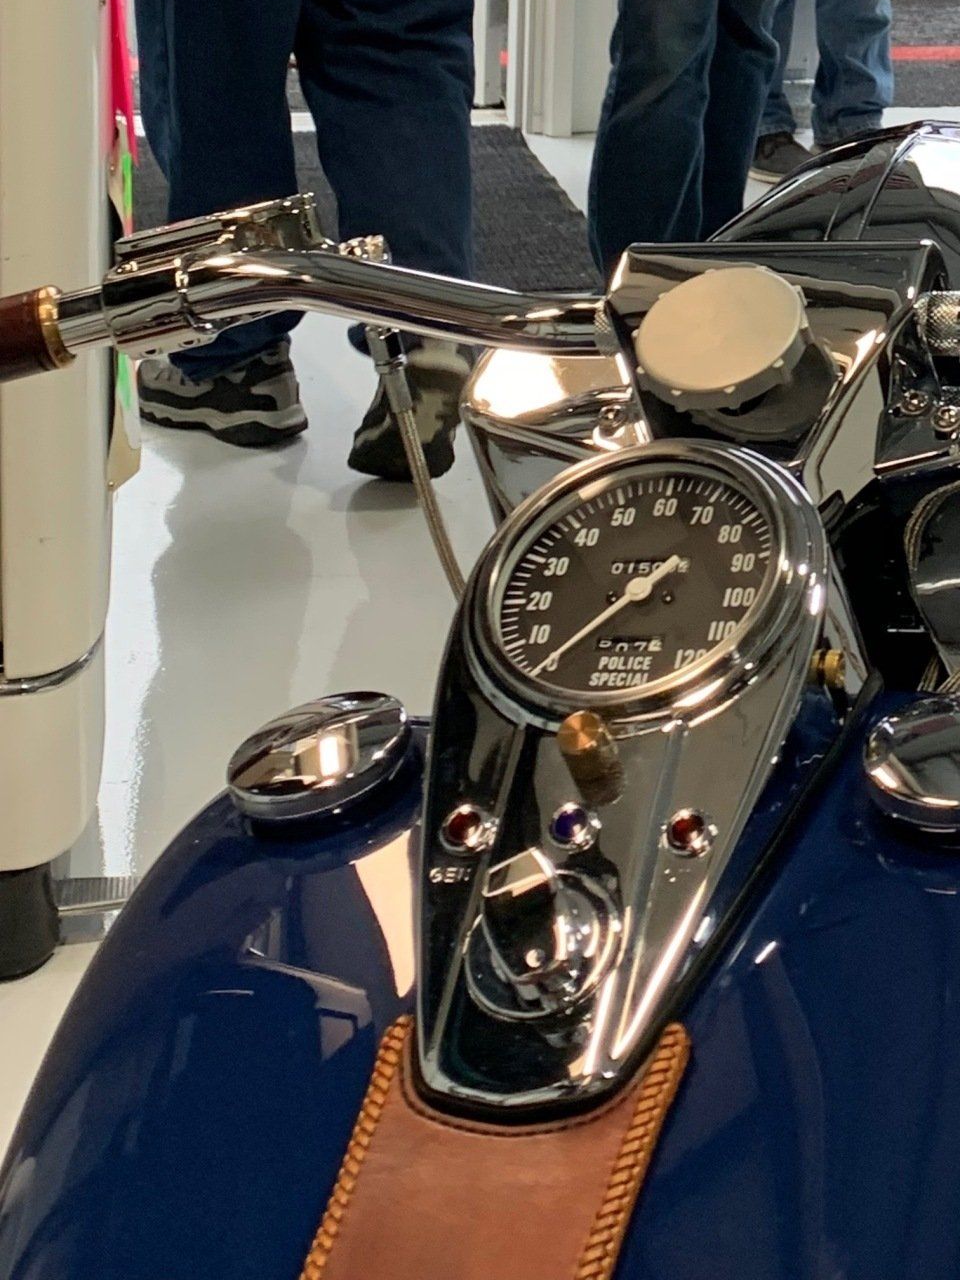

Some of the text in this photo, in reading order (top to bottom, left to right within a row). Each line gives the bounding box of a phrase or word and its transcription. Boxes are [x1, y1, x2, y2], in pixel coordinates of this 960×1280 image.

[611, 507, 636, 526] 50
[653, 498, 677, 516] 60
[690, 505, 714, 525] 70
[574, 527, 600, 547] 40
[717, 524, 742, 544] 80
[543, 557, 569, 576] 30
[730, 552, 755, 572] 90
[526, 591, 552, 611] 20
[722, 587, 755, 607] 100
[528, 624, 551, 644] 10
[707, 621, 738, 641] 110
[598, 656, 653, 670] POLICE
[589, 672, 649, 687] SPECIAL
